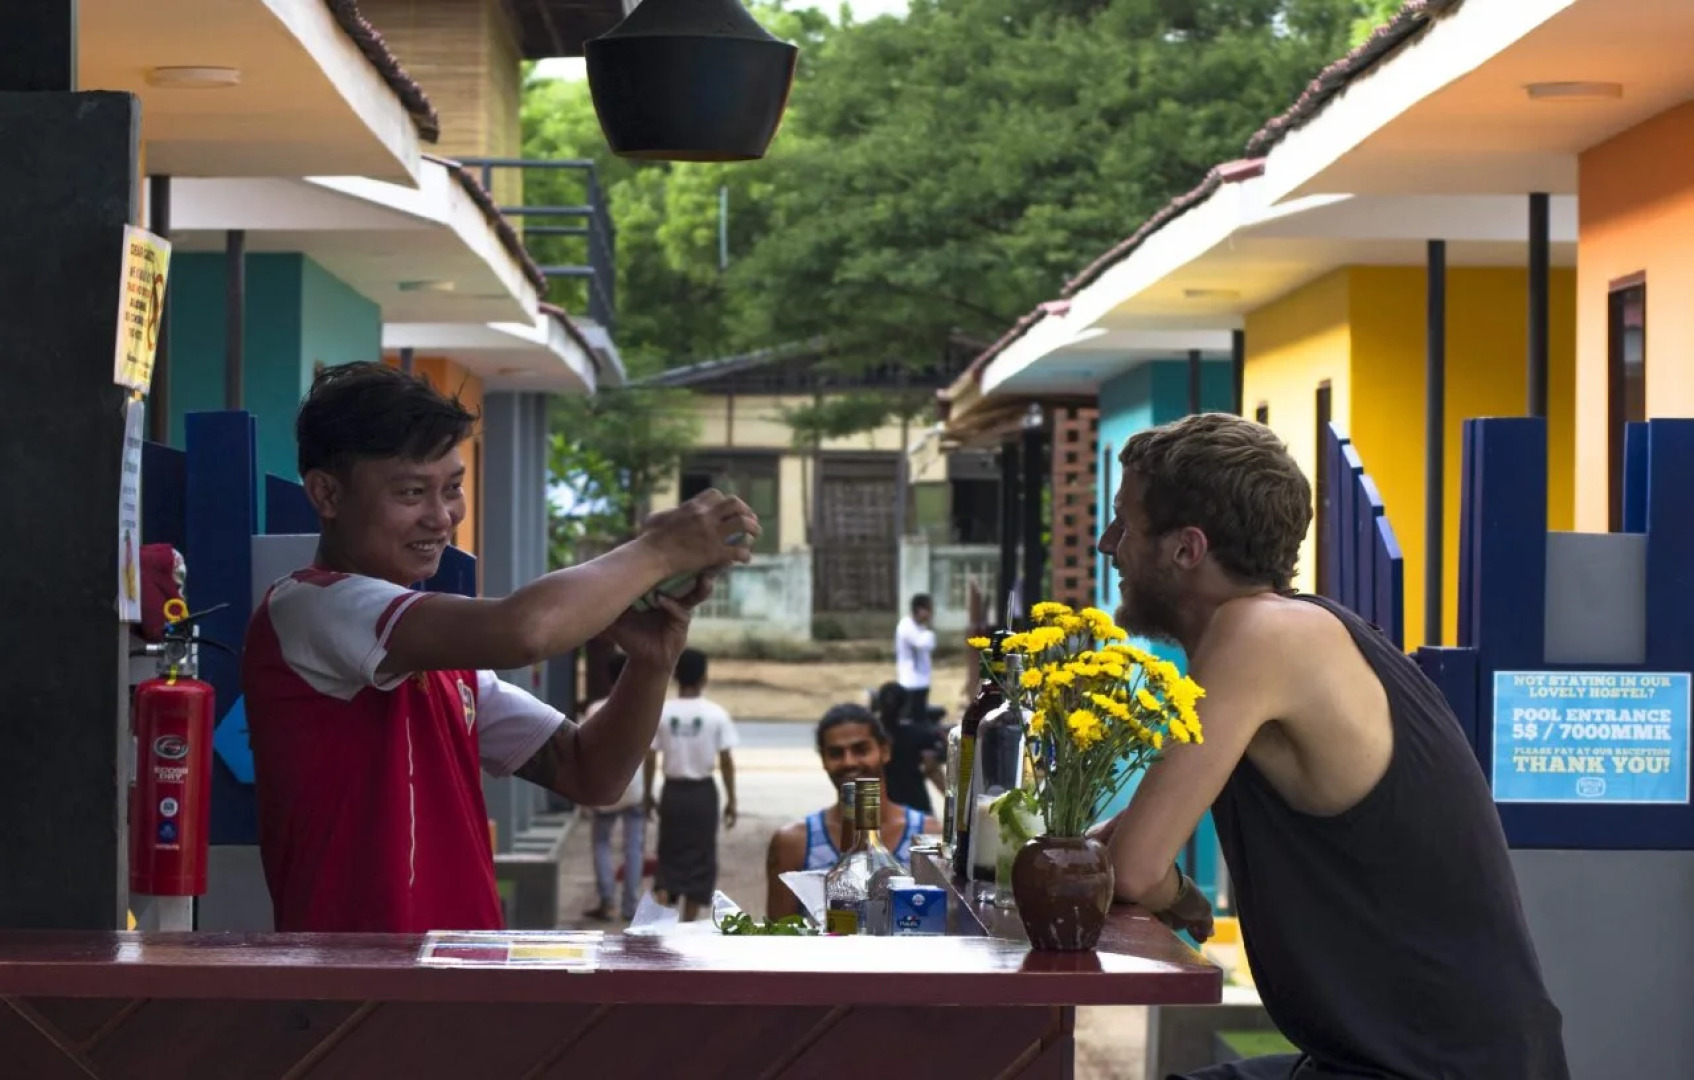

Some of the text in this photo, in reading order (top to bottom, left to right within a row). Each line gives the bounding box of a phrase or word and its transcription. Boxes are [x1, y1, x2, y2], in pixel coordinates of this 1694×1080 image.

[1514, 675, 1671, 687] NOT STAYING IN OUR
[1529, 687, 1655, 699] LOVELY HOSTEL?
[1513, 708, 1672, 722] POOL ENTRANCE
[1512, 723, 1672, 741] 5$ / 7000MMK
[1514, 747, 1552, 755] PLEASE
[1554, 747, 1575, 755] PAY
[1513, 756, 1671, 773] THANK YOU!
